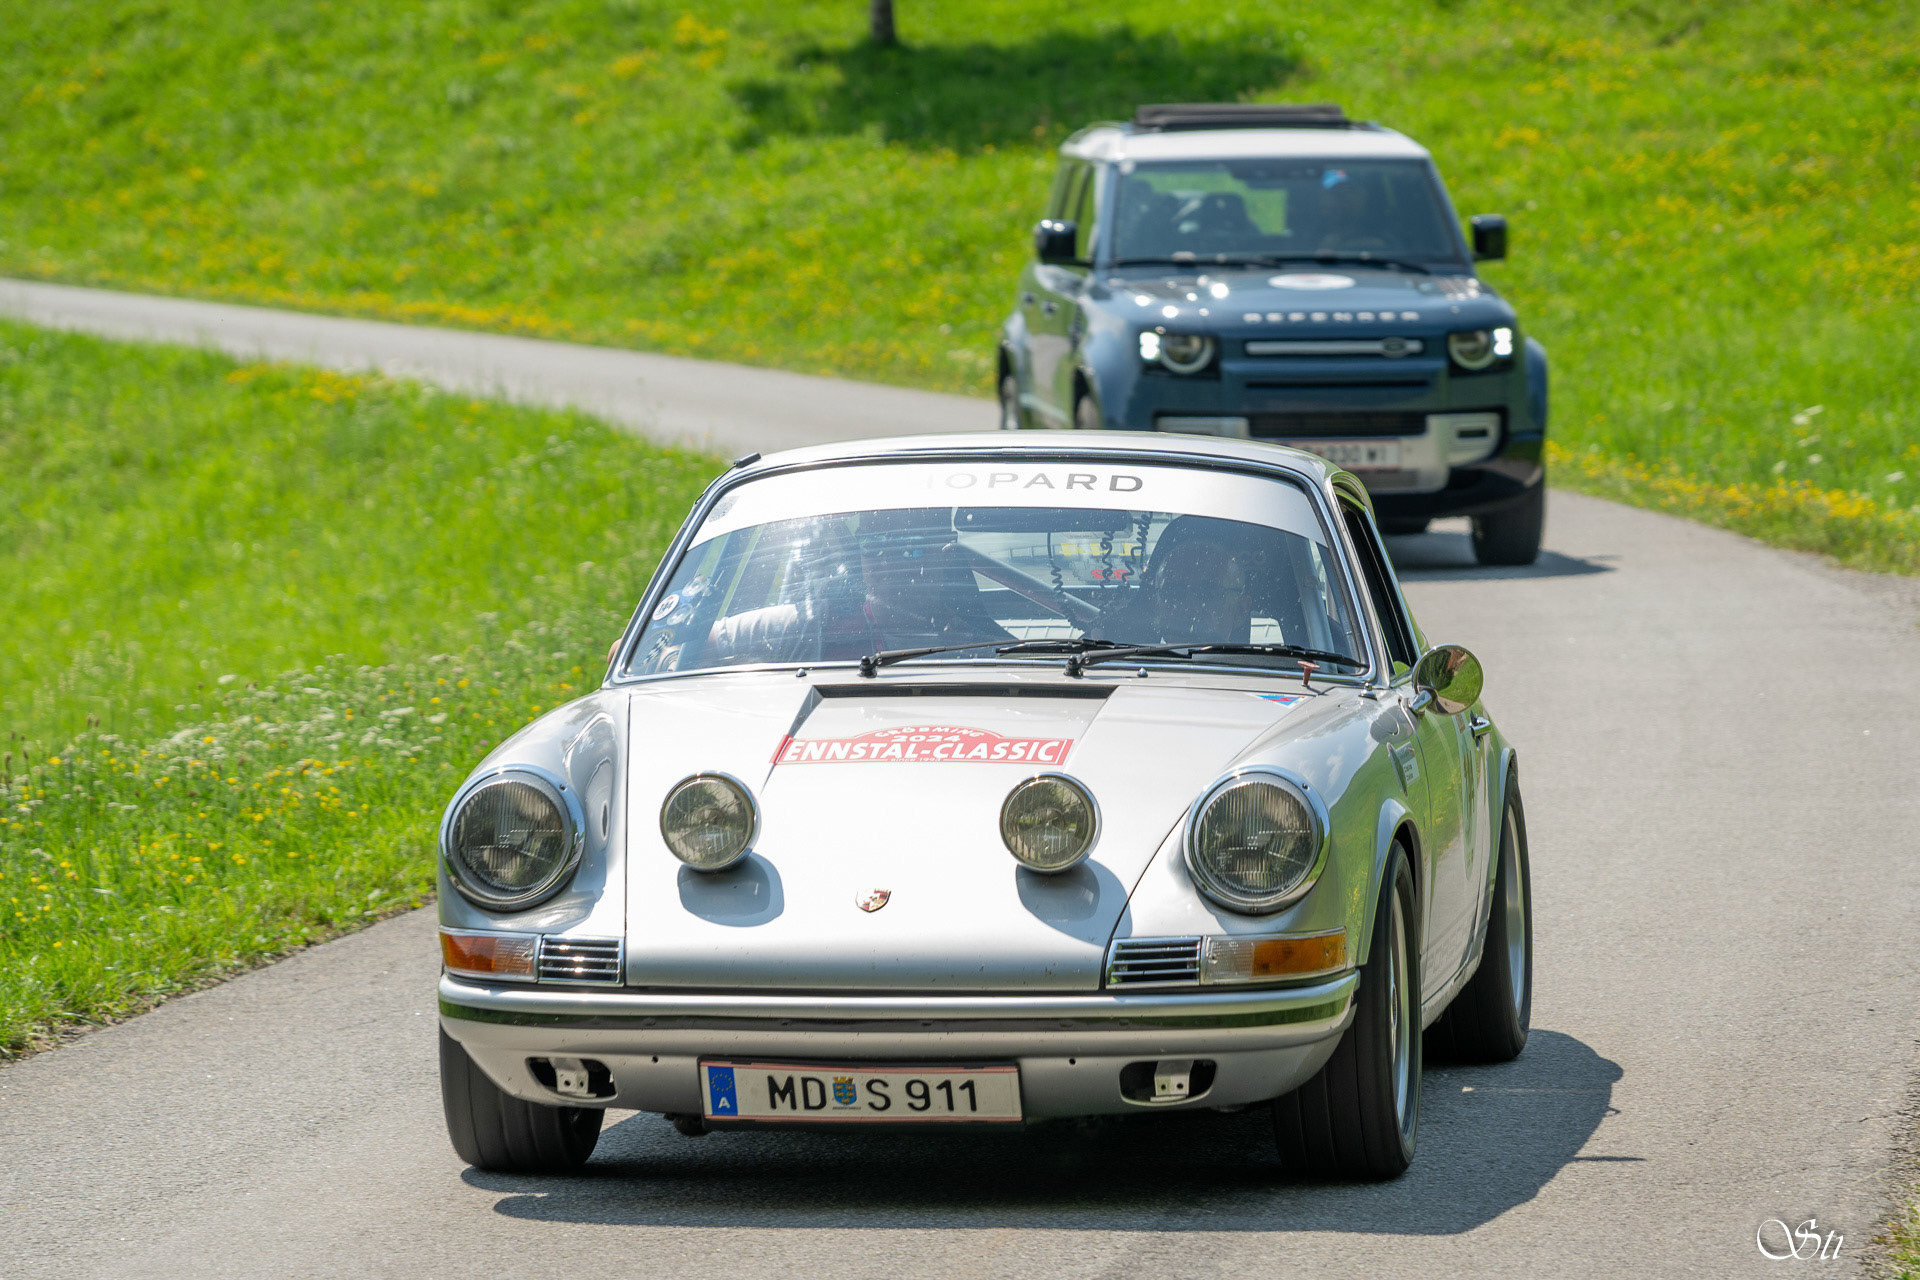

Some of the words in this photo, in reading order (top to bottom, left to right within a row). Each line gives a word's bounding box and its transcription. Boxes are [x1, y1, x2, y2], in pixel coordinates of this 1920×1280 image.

[874, 726, 985, 738] GRÖBMING
[890, 735, 962, 743] 2024
[782, 740, 1059, 762] ENNSTAL-CLASSIC
[767, 1074, 828, 1110] MD
[865, 1078, 892, 1112] S
[904, 1079, 978, 1112] 911
[718, 1096, 731, 1109] A
